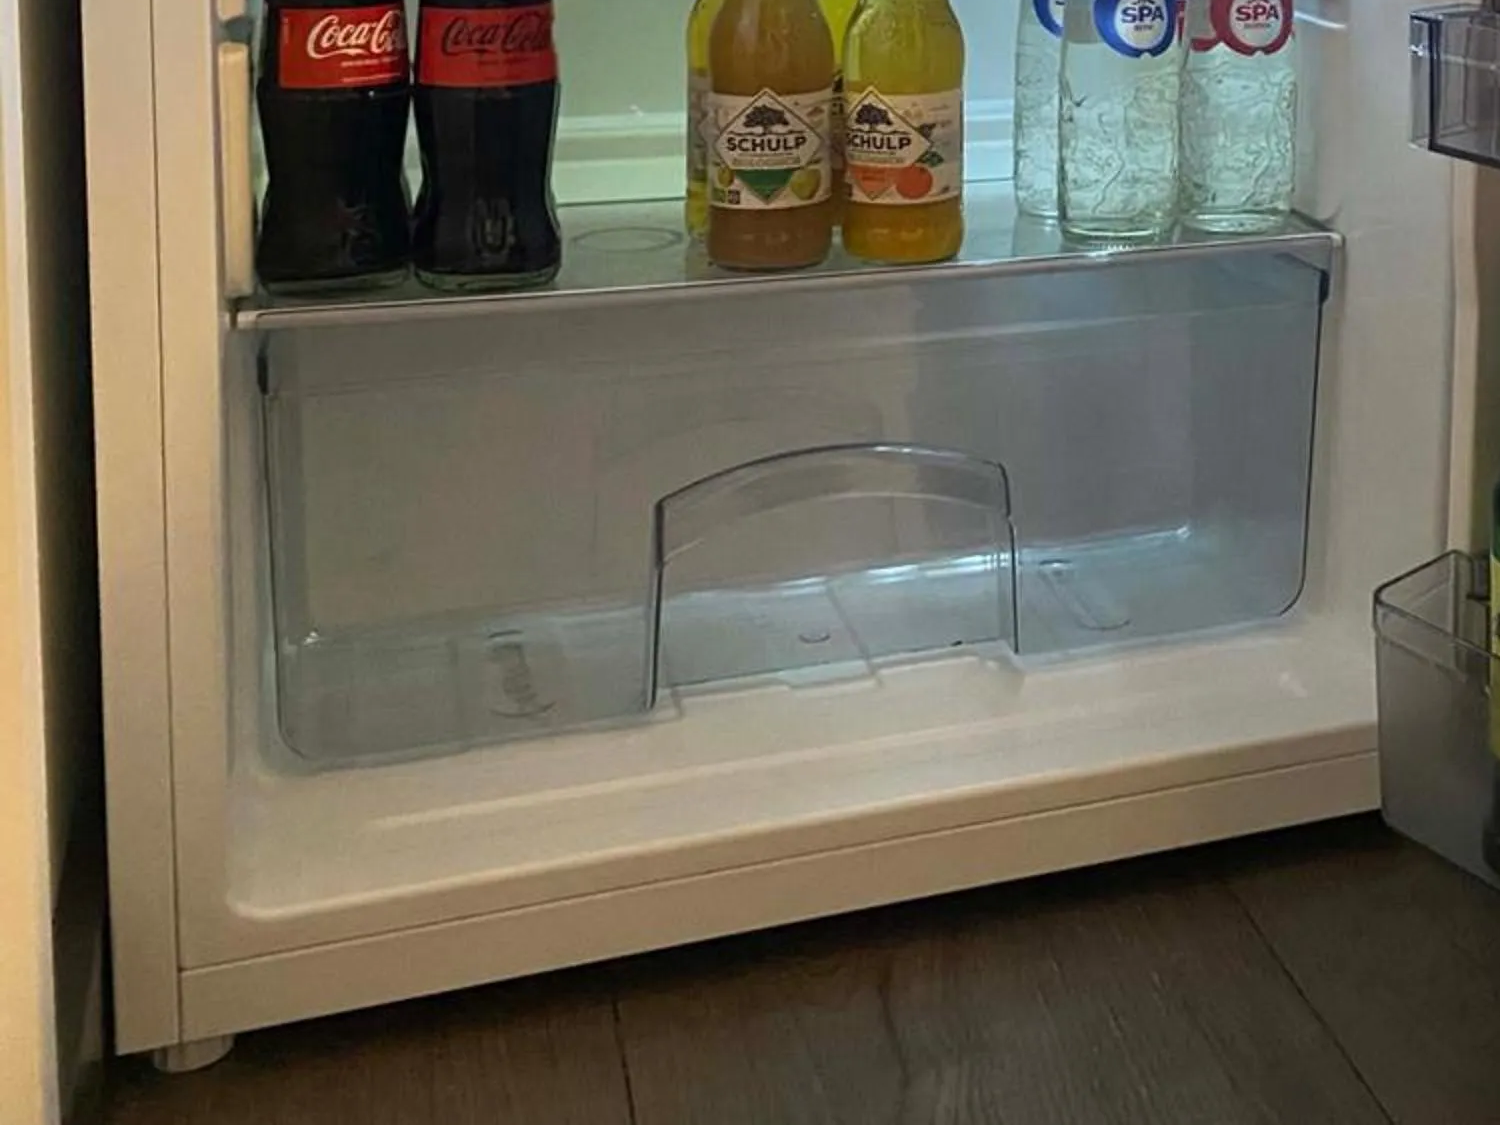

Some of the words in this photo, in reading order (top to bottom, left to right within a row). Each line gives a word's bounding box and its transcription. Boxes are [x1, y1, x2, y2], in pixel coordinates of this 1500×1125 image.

[1121, 6, 1165, 24] SPA
[1235, 5, 1279, 22] SPA
[726, 136, 807, 153] SCHULP
